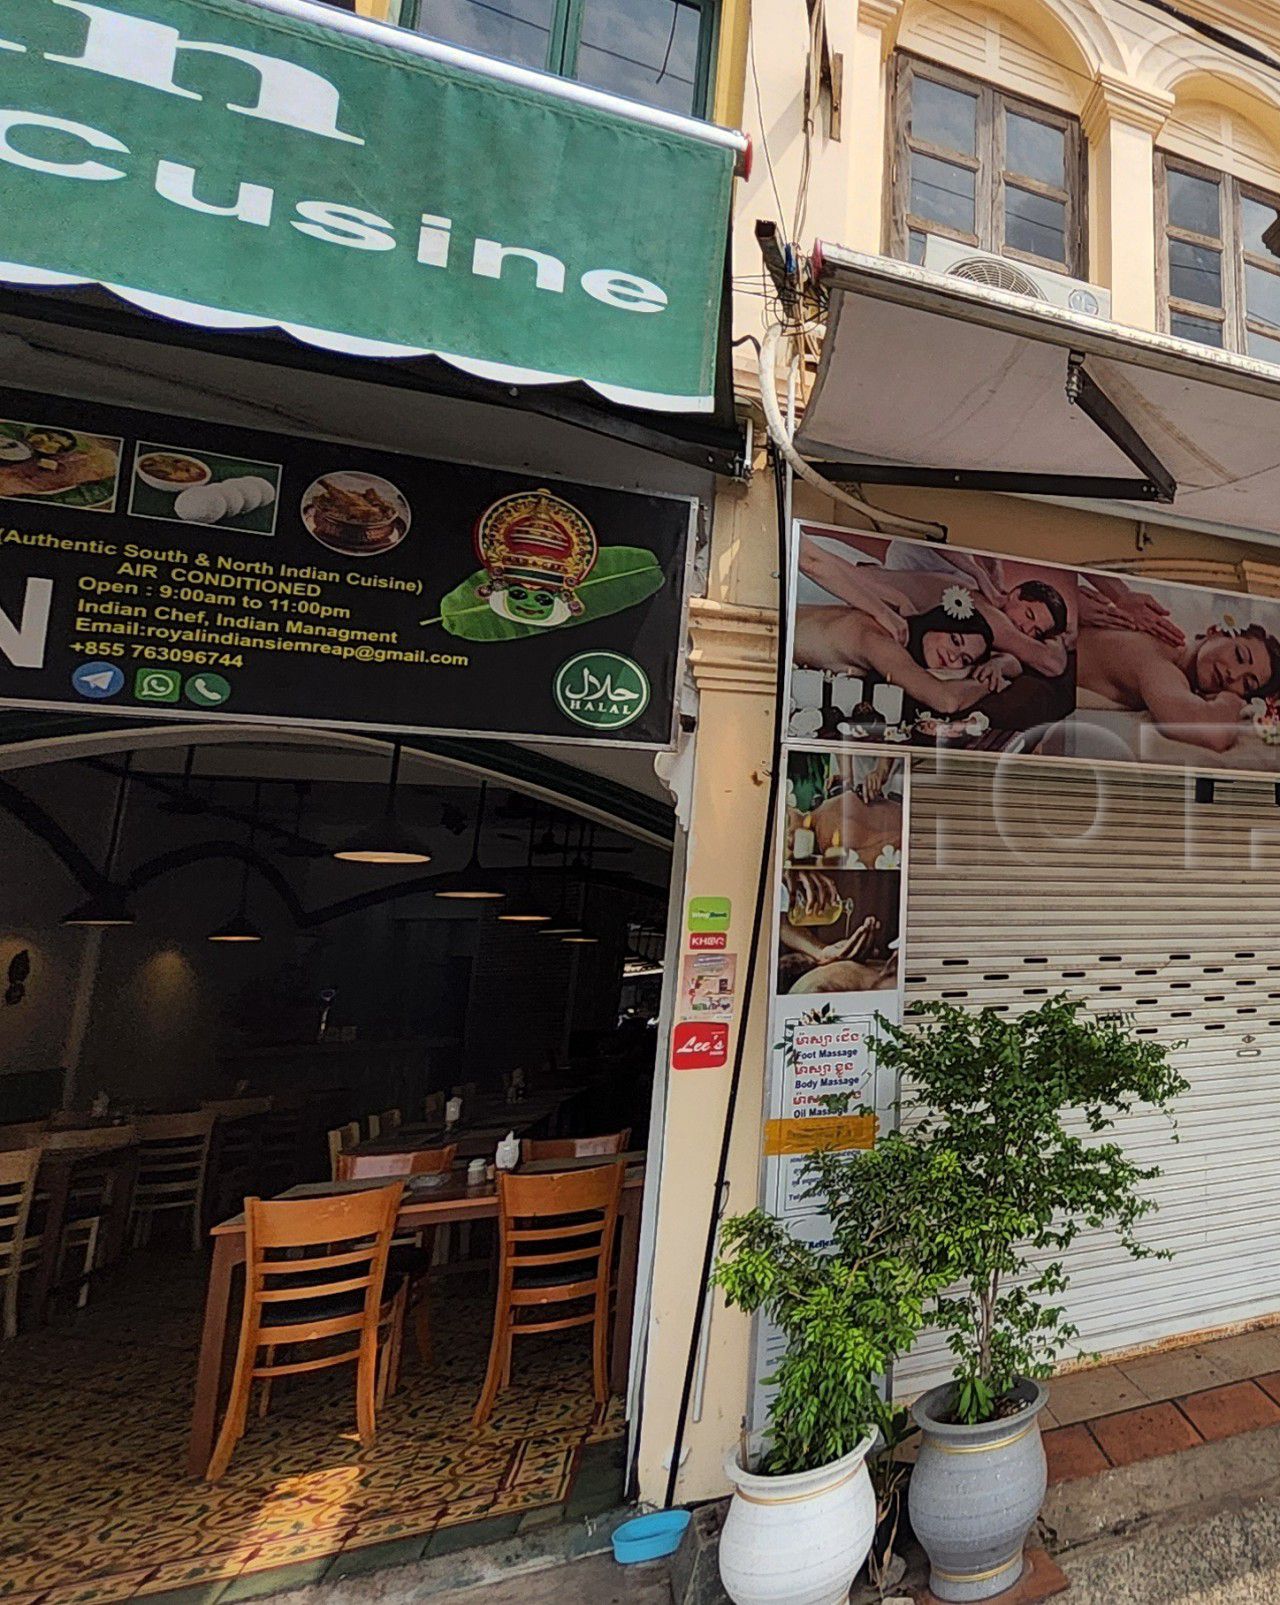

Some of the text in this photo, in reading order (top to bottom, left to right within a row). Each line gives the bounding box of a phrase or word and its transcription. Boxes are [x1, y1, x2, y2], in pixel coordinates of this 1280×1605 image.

[0, 0, 365, 146] n
[0, 109, 669, 313] Cusine
[0, 527, 423, 595] (Authentic South & North Indian Cuisine)
[78, 576, 138, 595] Open
[159, 584, 236, 606] 9:00am
[242, 595, 263, 610] to
[269, 598, 351, 619] 11:00pm
[117, 562, 321, 599] AIR CONDITIONED
[77, 598, 398, 644] Indian Chef, Indian Managment
[69, 641, 243, 668] +855 763096744
[75, 617, 469, 667] Email:royalindiansiemreap@gmail.com
[565, 667, 640, 701] حلال
[570, 700, 632, 715] HALAL
[676, 1034, 725, 1054] Lee's
[796, 1048, 859, 1060] Foot Massage
[794, 1077, 860, 1090] Body Massage
[793, 1109, 806, 1119] Oil
